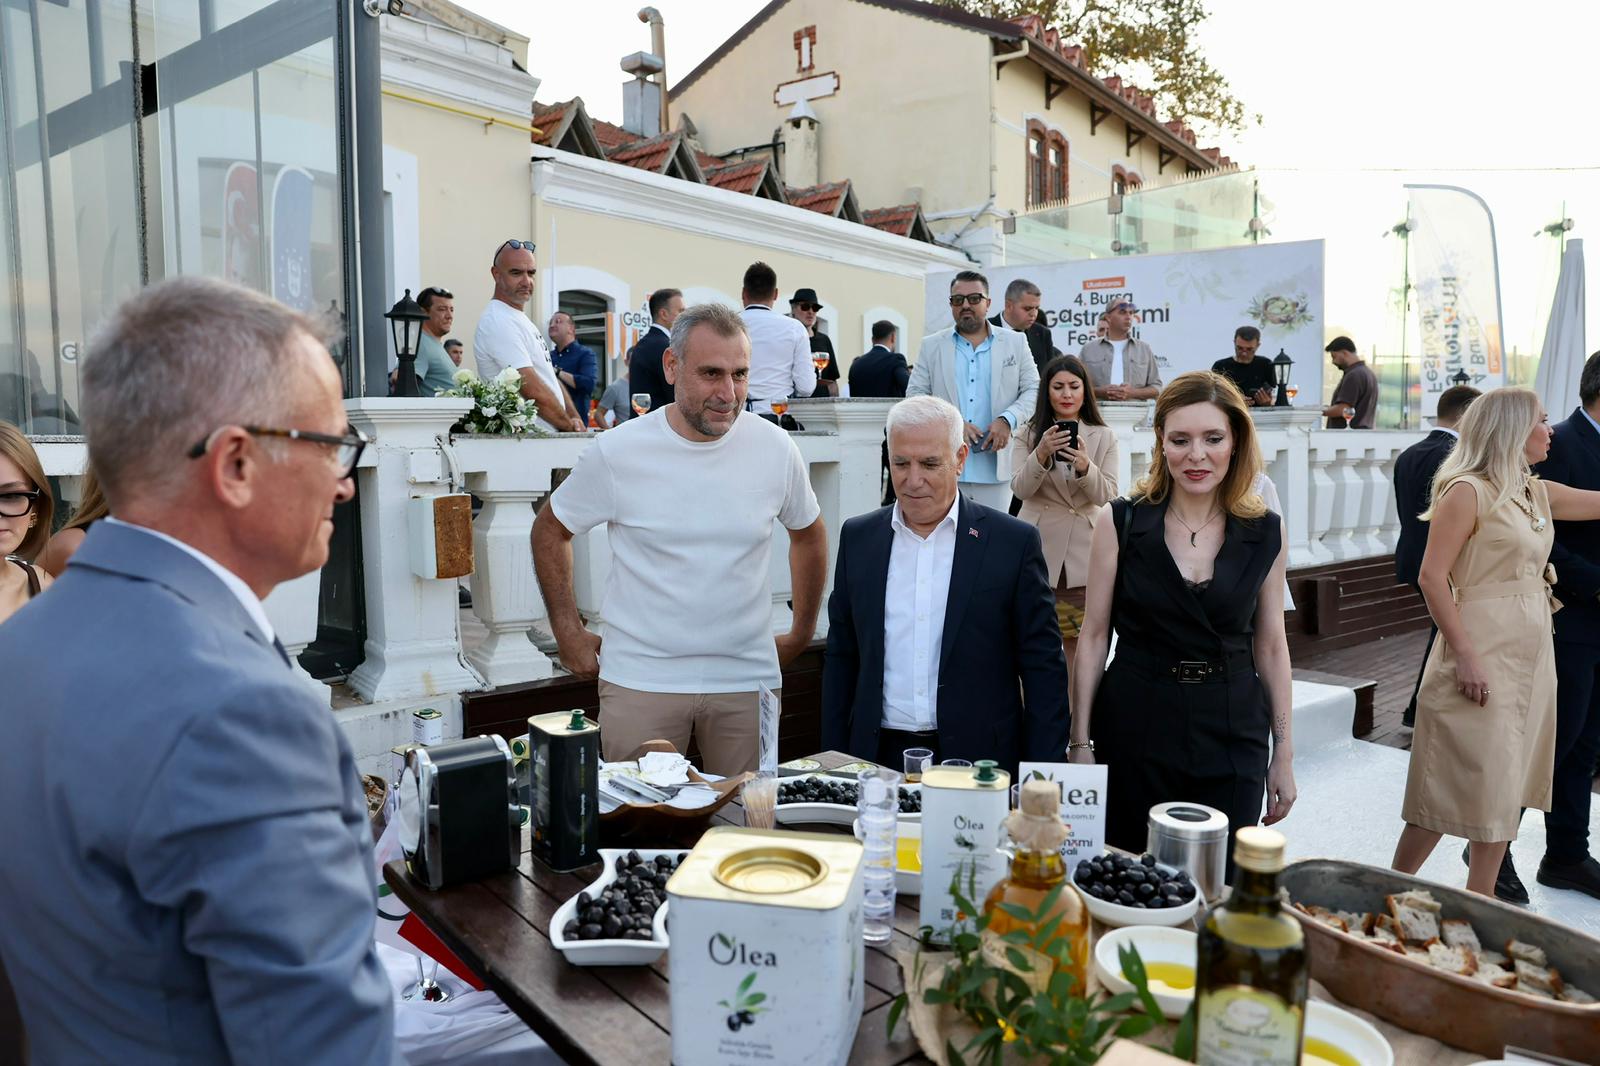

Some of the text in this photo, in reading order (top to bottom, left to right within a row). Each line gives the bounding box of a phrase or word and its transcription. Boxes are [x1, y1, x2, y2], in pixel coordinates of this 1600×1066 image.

[1074, 293, 1088, 306] 4.
[953, 814, 985, 831] Olea
[708, 932, 778, 968] Olea
